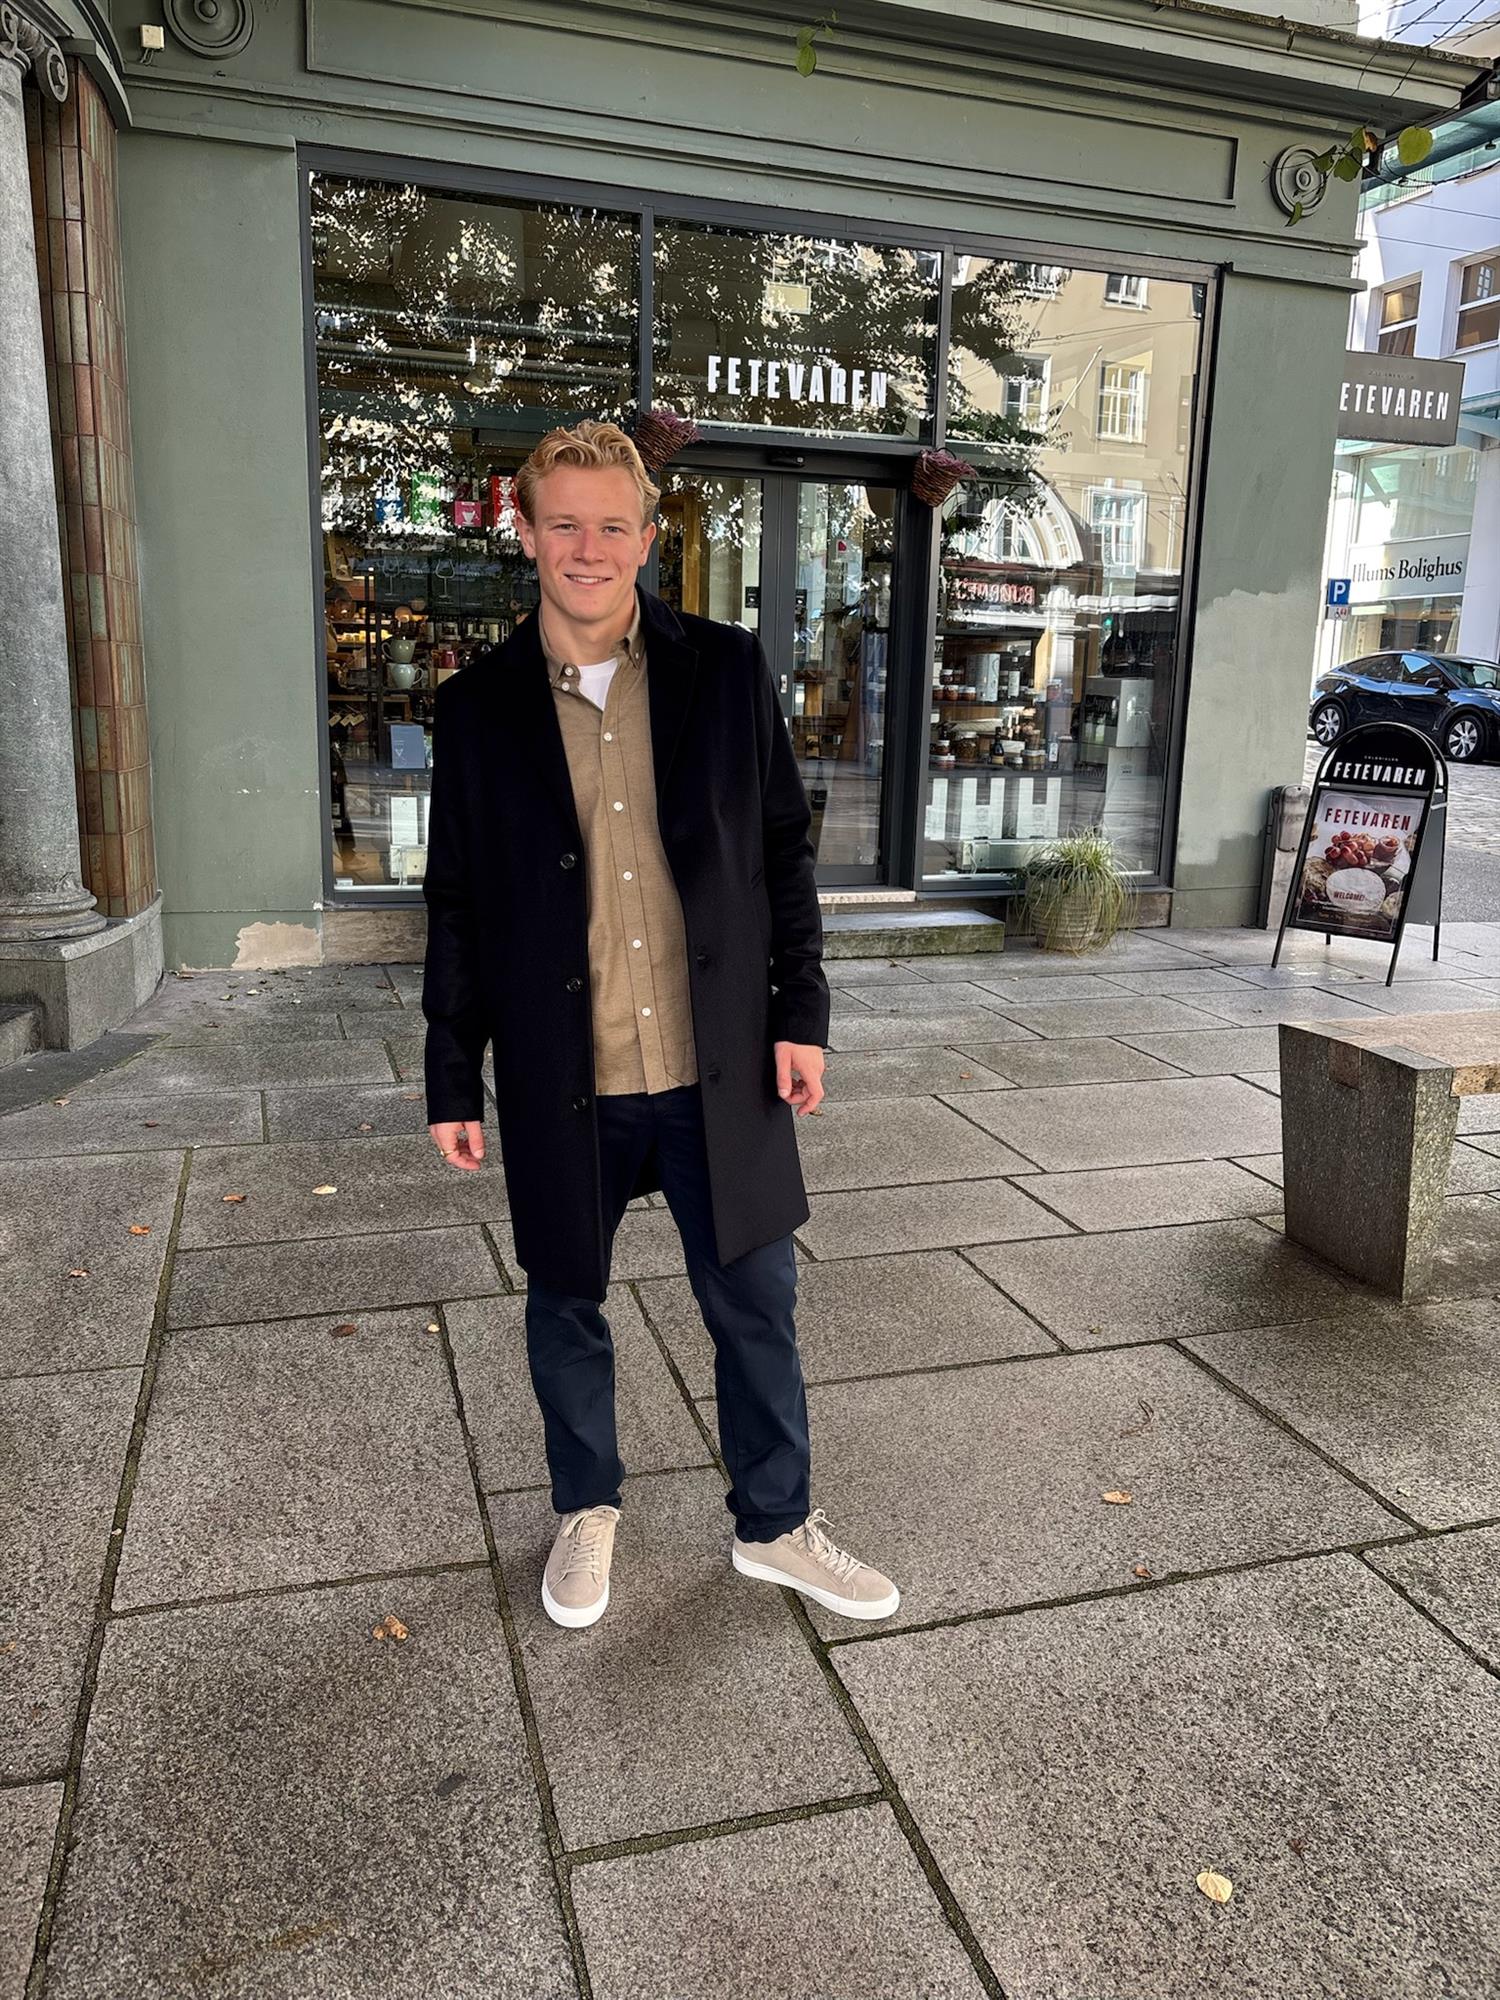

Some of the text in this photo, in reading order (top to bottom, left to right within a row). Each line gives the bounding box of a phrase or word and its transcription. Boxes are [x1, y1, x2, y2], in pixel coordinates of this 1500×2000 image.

[707, 355, 888, 410] FETEVAREN
[1339, 382, 1449, 421] ETEVAREN
[1352, 556, 1463, 583] Illums Bolighus
[1333, 581, 1346, 602] P
[1332, 761, 1426, 786] FETEVAREN
[1324, 807, 1412, 832] FETEVAREN
